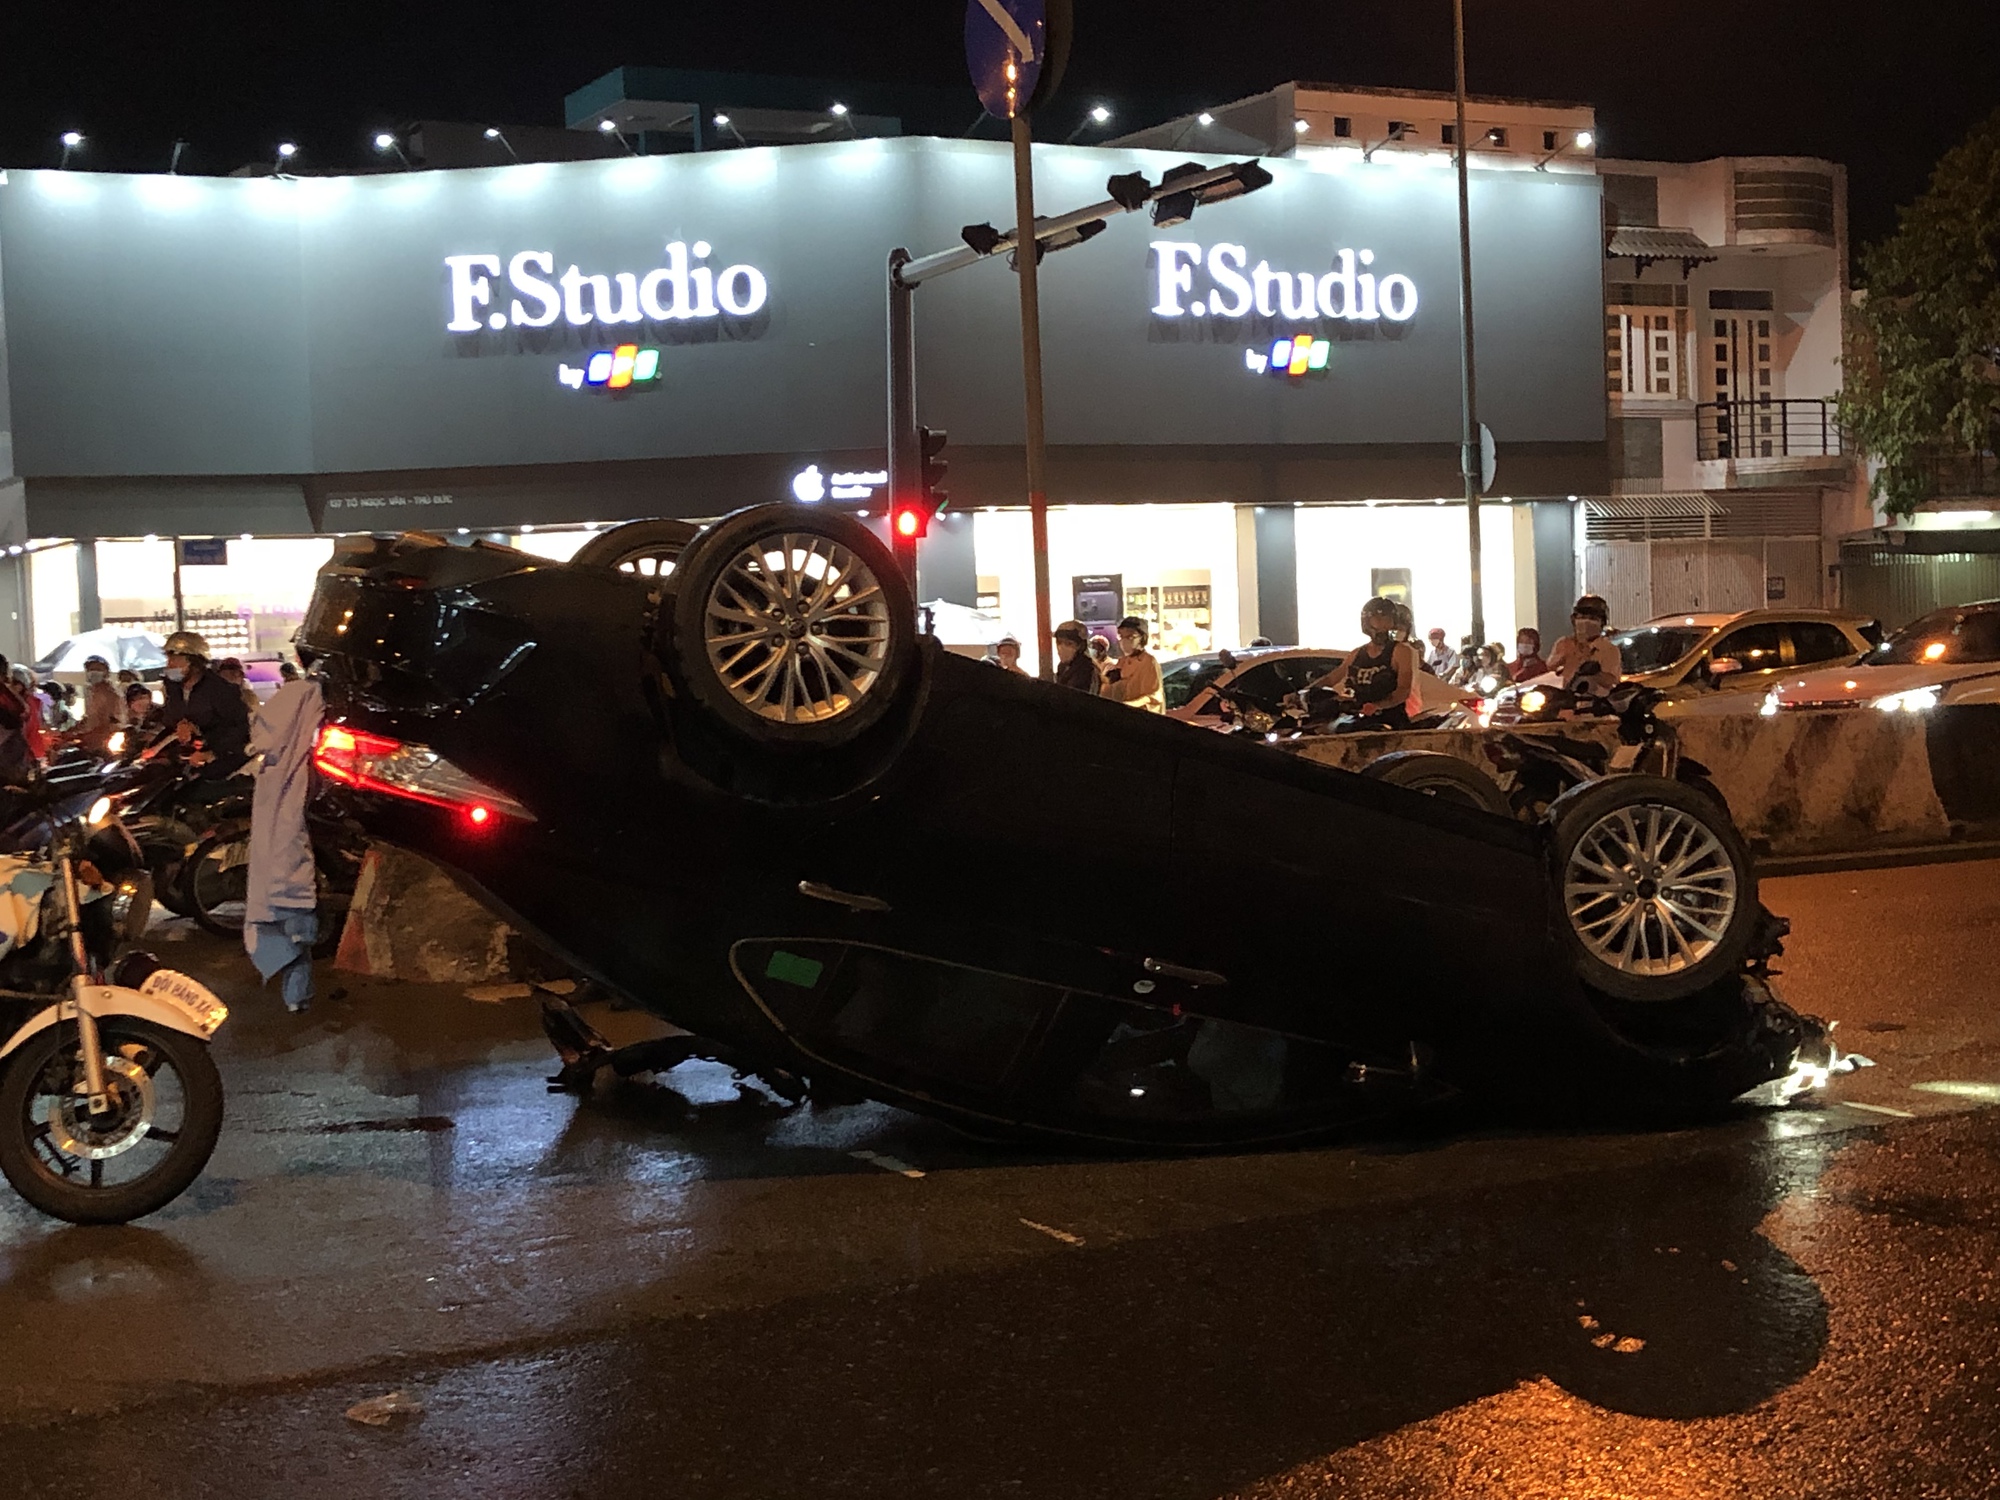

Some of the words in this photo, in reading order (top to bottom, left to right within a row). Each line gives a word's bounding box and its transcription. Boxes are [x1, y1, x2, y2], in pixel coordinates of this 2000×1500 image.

[445, 241, 768, 332] F.Studio
[1150, 241, 1418, 321] F.Studio
[559, 364, 585, 389] by
[1246, 348, 1268, 374] by
